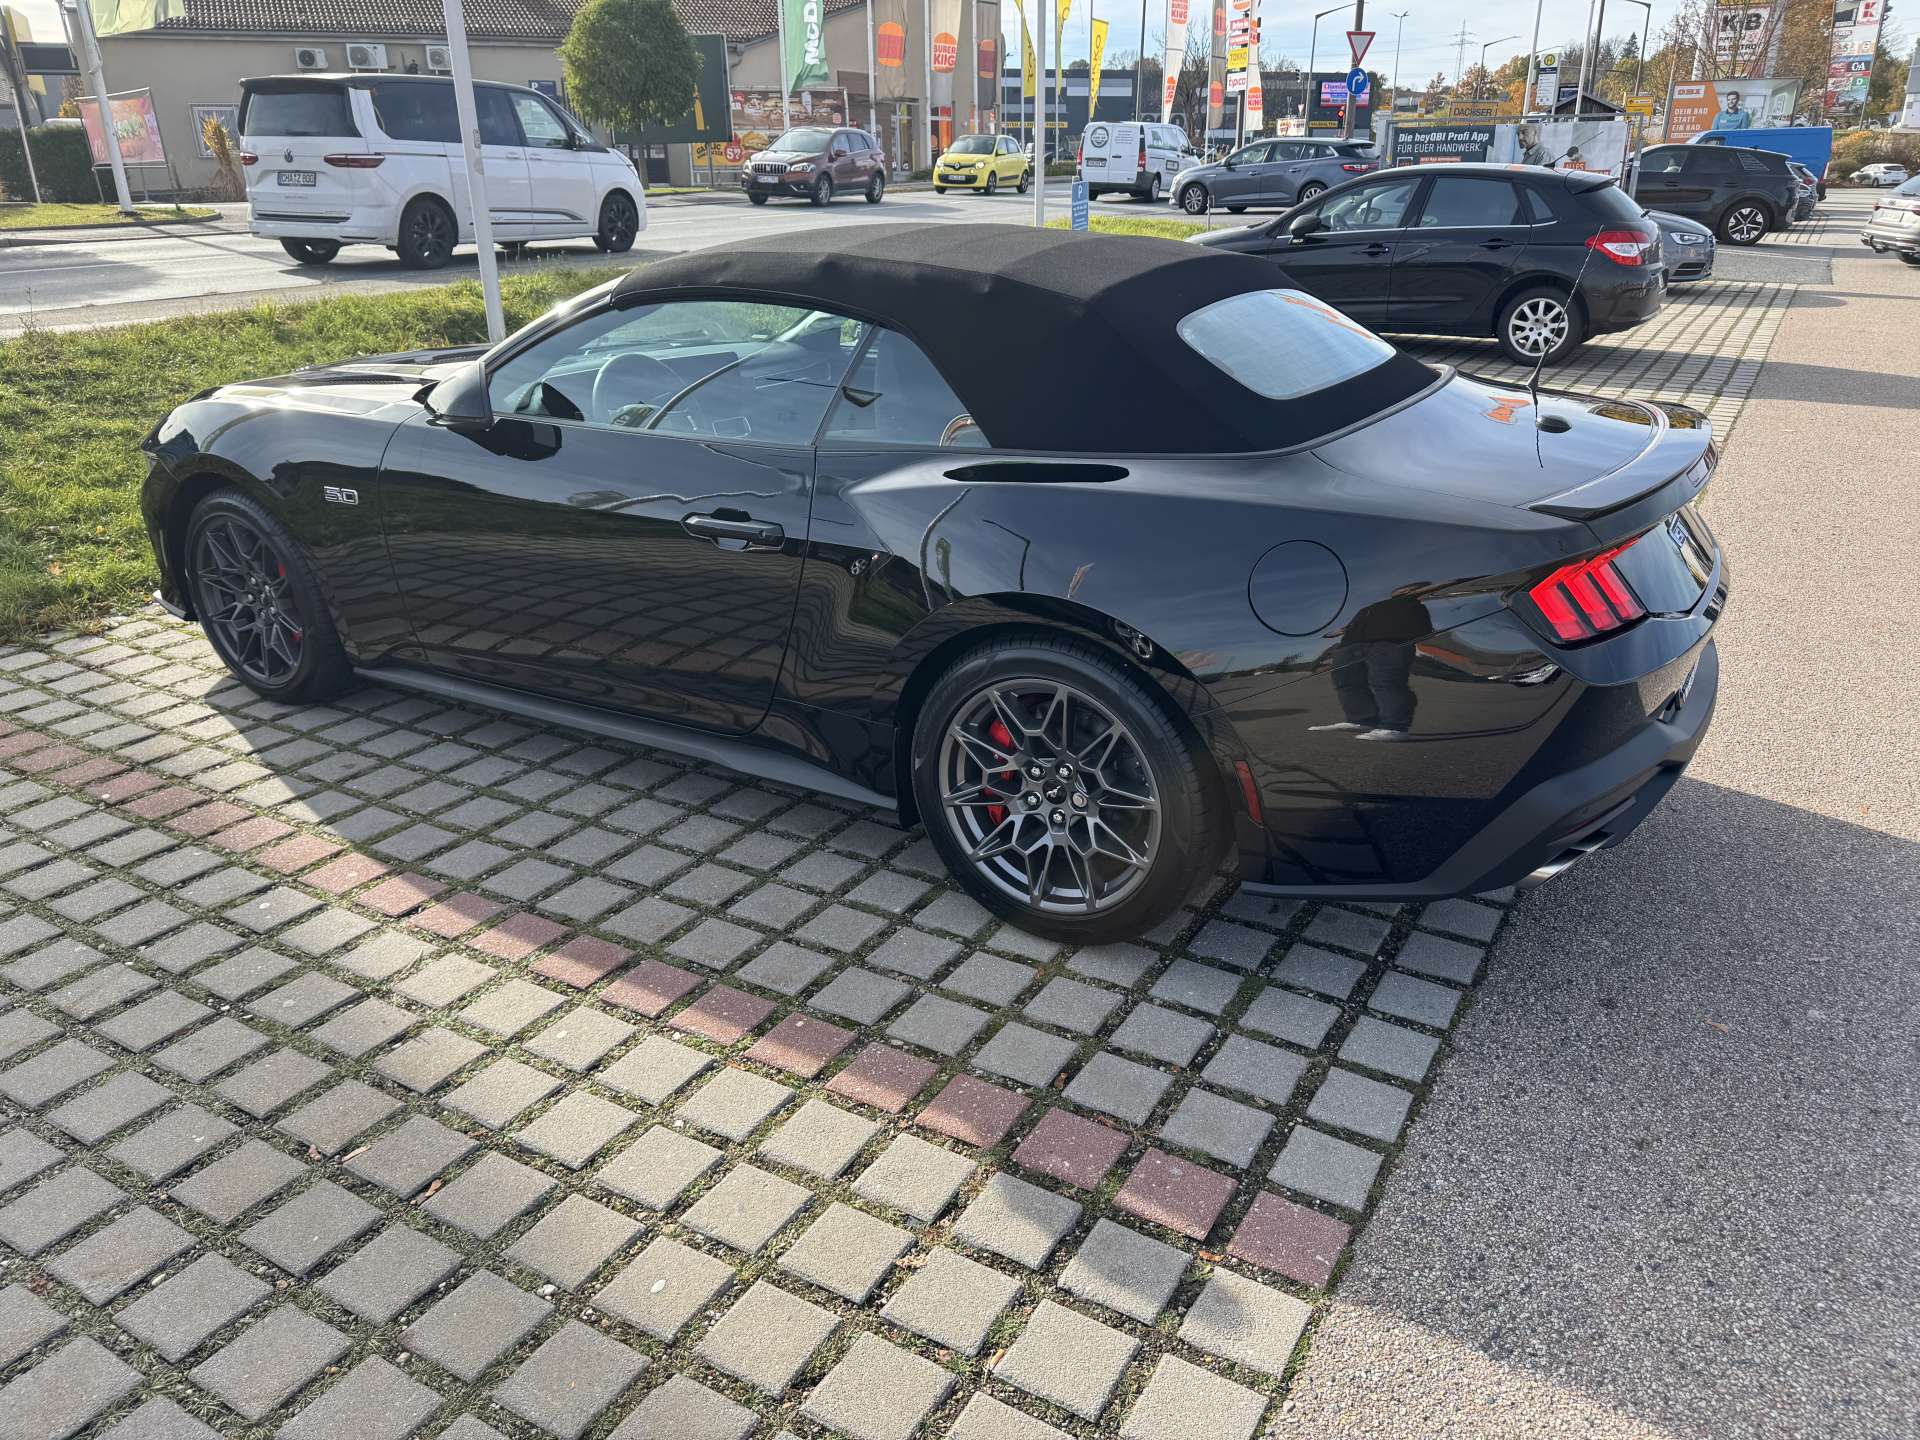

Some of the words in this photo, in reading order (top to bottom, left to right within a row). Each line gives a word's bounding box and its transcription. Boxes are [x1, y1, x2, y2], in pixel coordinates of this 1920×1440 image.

[1453, 108, 1493, 117] DACHSER
[1693, 107, 1709, 115] BAD
[1398, 133, 1413, 142] Die
[1447, 132, 1471, 141] Profi
[1471, 132, 1490, 142] App
[1397, 143, 1412, 153] FÜR
[1414, 143, 1434, 153] EUER
[1436, 142, 1483, 152] HANDWERK.
